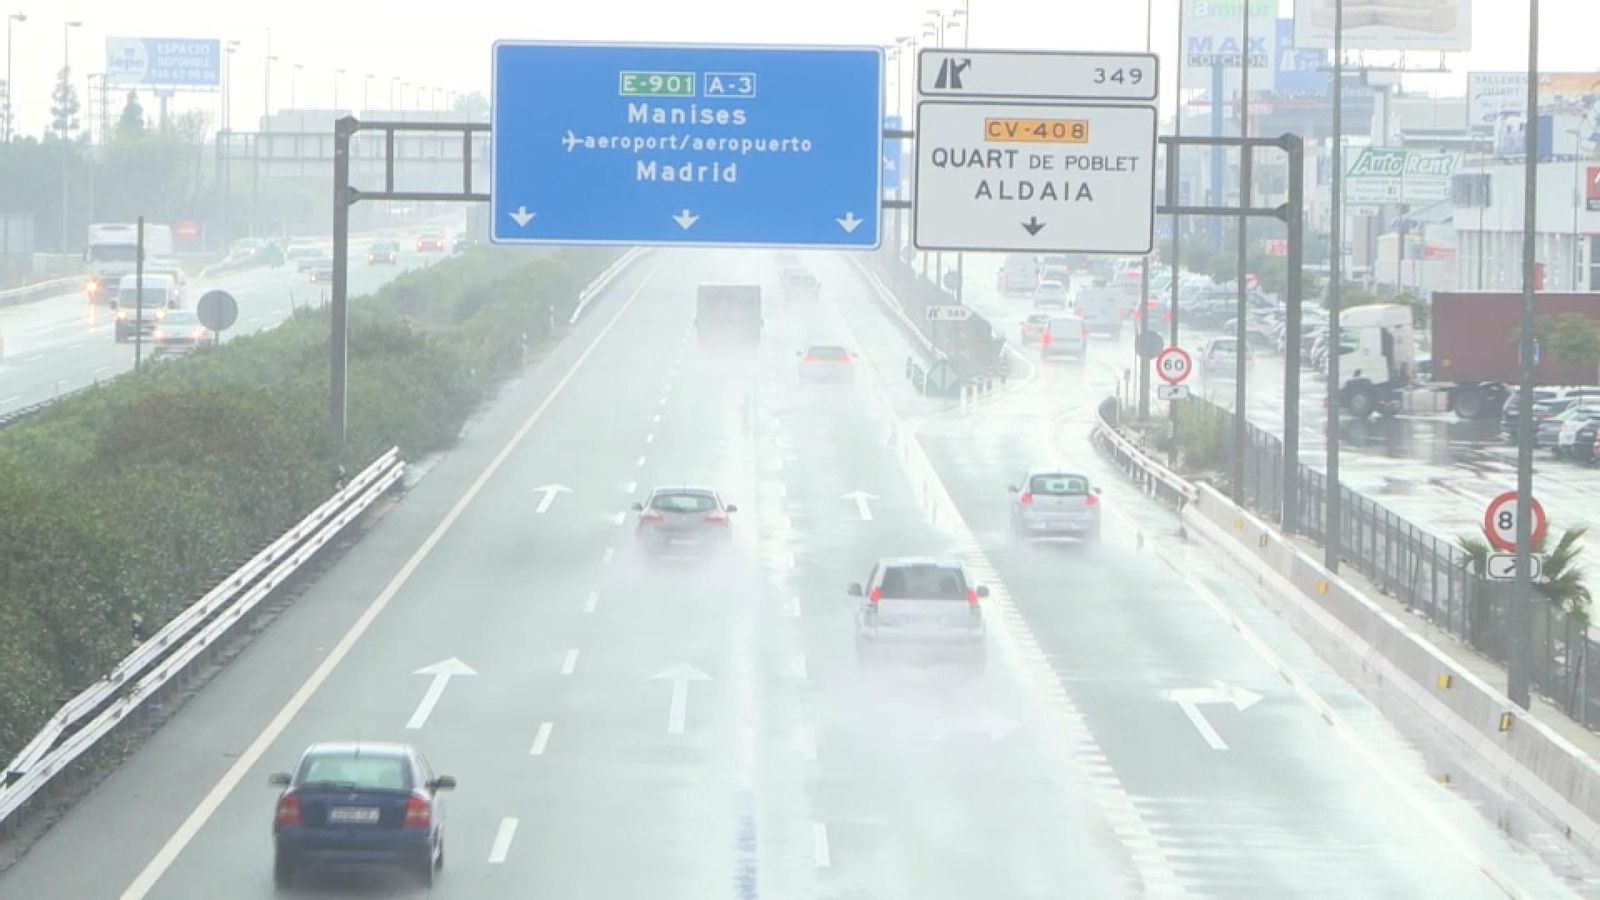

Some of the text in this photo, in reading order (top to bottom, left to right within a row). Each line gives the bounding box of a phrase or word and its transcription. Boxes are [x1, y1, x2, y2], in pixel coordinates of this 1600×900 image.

[157, 43, 210, 54] ESPACIO
[1188, 36, 1266, 52] MAX
[623, 75, 753, 94] E-901 A-3
[1093, 67, 1143, 85] 349
[627, 103, 746, 125] Manises
[987, 121, 1085, 139] CV-408
[584, 133, 812, 155] aeroport/aeropuerto
[931, 147, 1139, 173] QUART DE POBLET
[1355, 152, 1452, 175] Auto Rent
[636, 160, 737, 183] Madrid
[974, 180, 1093, 202] ALDAIA
[1164, 358, 1184, 371] 60
